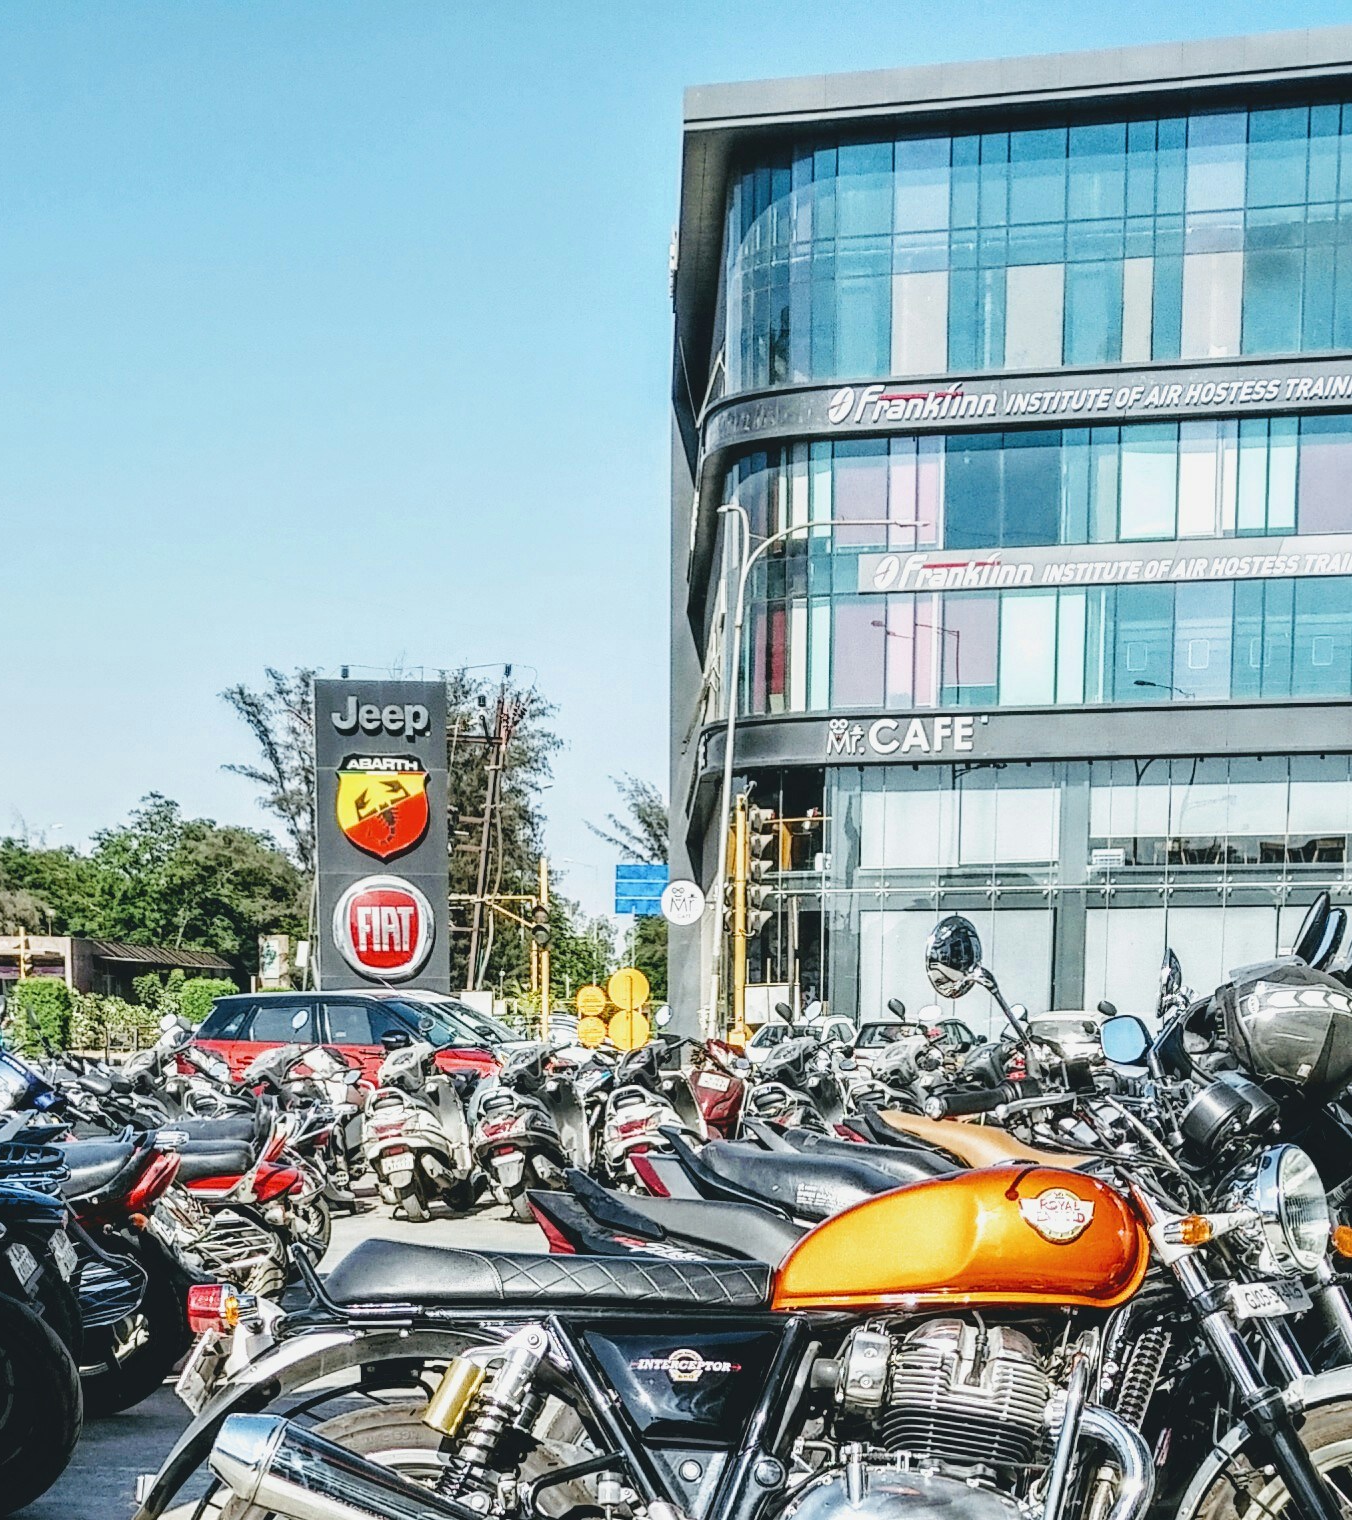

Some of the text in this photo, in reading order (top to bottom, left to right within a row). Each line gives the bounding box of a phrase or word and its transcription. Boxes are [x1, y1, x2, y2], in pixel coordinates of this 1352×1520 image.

[1005, 387, 1114, 414] INSTITUTE
[1115, 385, 1144, 409] OF
[1146, 383, 1184, 408] AIR
[1185, 379, 1281, 405] HOSTESS
[1042, 560, 1140, 583] INSTITUTE
[1143, 558, 1173, 579] OF
[1171, 556, 1210, 579] AIR
[1210, 554, 1301, 577] HOSTESS
[331, 695, 431, 738] Jeep
[826, 716, 975, 754] Mr. CAFE
[346, 757, 419, 771] ABARTH
[356, 906, 416, 952] FIAT
[637, 1358, 732, 1372] INTERCEPTOR
